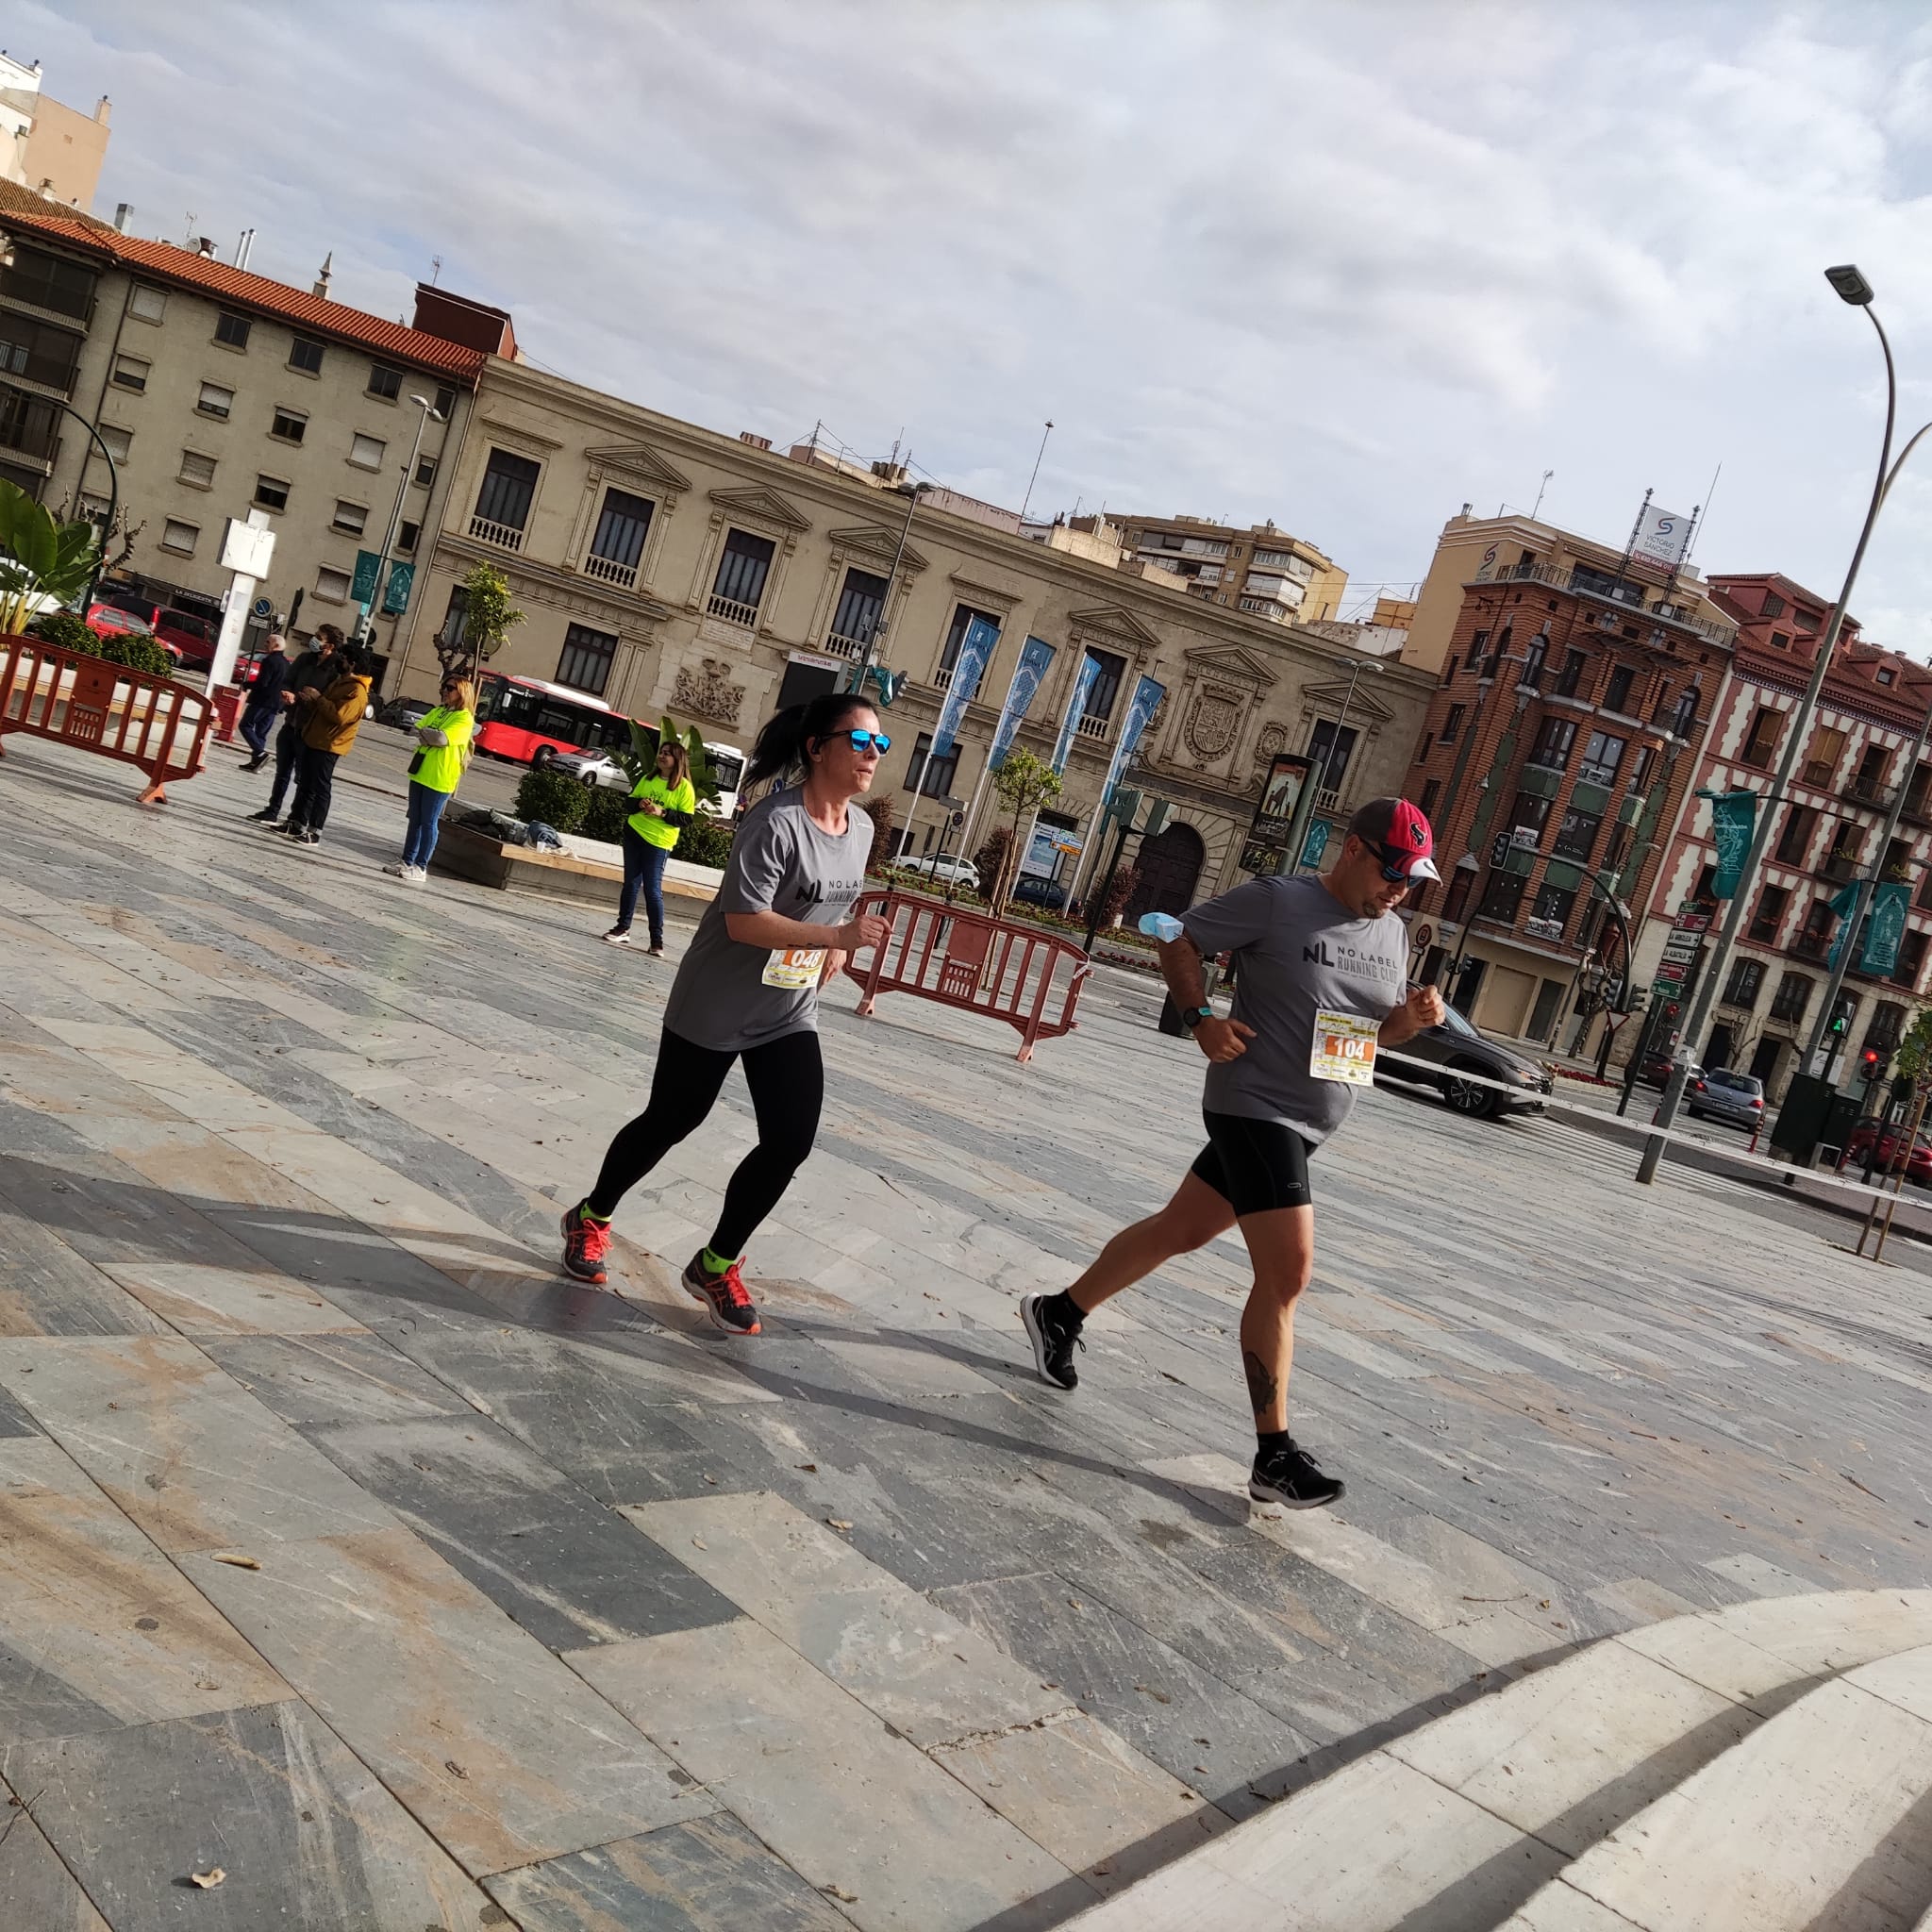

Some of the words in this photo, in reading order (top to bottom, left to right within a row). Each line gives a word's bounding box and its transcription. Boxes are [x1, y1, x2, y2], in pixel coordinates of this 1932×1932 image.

[828, 879, 842, 889] NO
[791, 949, 822, 968] 048
[1303, 940, 1335, 968] NL
[1338, 946, 1356, 958] NO
[1360, 953, 1398, 969] LABEL
[1338, 956, 1377, 979] RUNNING
[1334, 1038, 1365, 1060] 104
